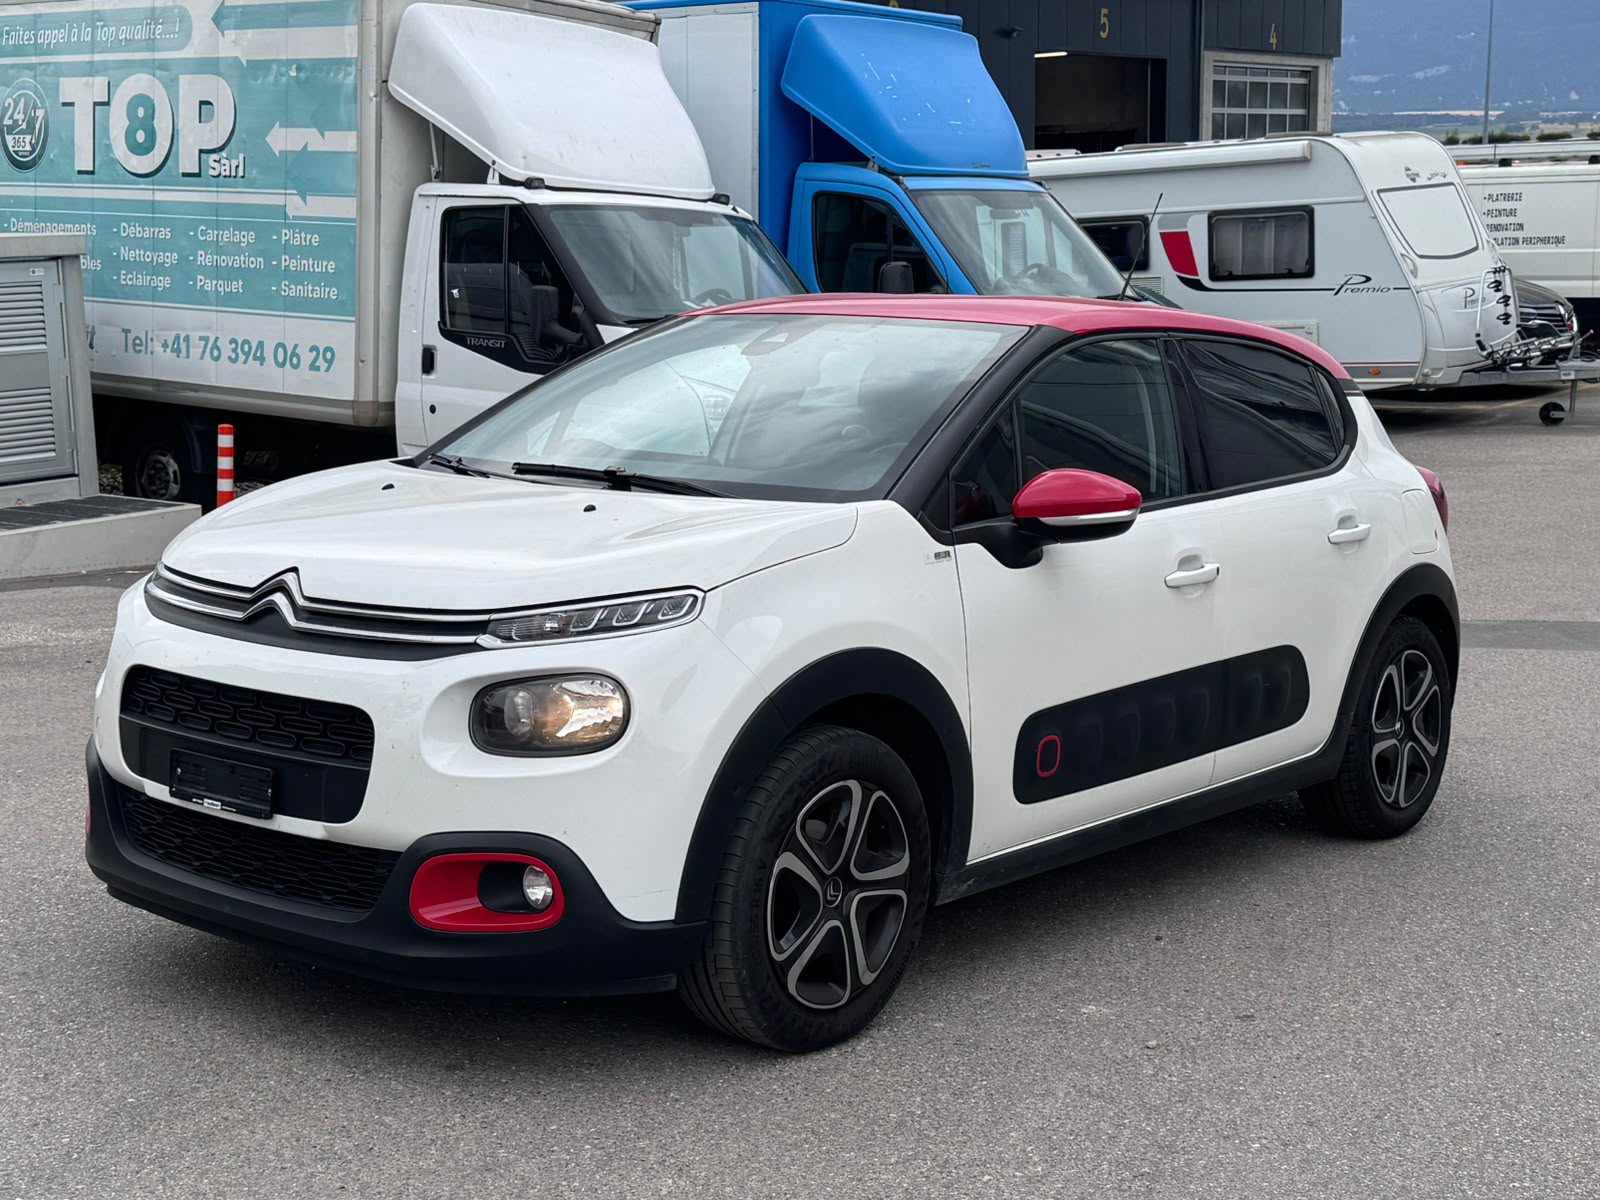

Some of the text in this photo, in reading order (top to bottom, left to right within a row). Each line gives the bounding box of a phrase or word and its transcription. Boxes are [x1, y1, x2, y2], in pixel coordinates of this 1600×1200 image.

[1100, 8, 1109, 39] 5
[2, 26, 35, 46] Faites
[38, 23, 69, 48] appel
[71, 24, 78, 42] à
[81, 22, 92, 42] la
[96, 22, 115, 47] Top
[1269, 24, 1277, 50] 4
[11, 136, 27, 149] 365
[1487, 192, 1523, 203] PLATRERIE
[1486, 208, 1518, 218] PEINTURE
[10, 217, 97, 236] Déménagements
[120, 222, 172, 239] Débarras
[197, 225, 256, 247] Carrelage
[281, 229, 320, 246] Plâtre
[1522, 235, 1566, 248] PERIPHERIQUE
[80, 255, 102, 270] bles
[120, 246, 179, 267] Nettoyage
[197, 250, 264, 269] Rénovation
[281, 255, 336, 273] Peinture
[120, 270, 172, 291] Eclairage
[196, 275, 243, 296] Parquet
[281, 281, 338, 299] Sanitaire
[1333, 273, 1391, 296] Premio
[121, 328, 154, 355] Tel:
[161, 333, 191, 359] +41
[198, 335, 222, 362] 76
[227, 338, 266, 366] 394
[273, 342, 301, 370] 06
[308, 345, 336, 373] 29
[466, 336, 505, 348] TRANSIT
